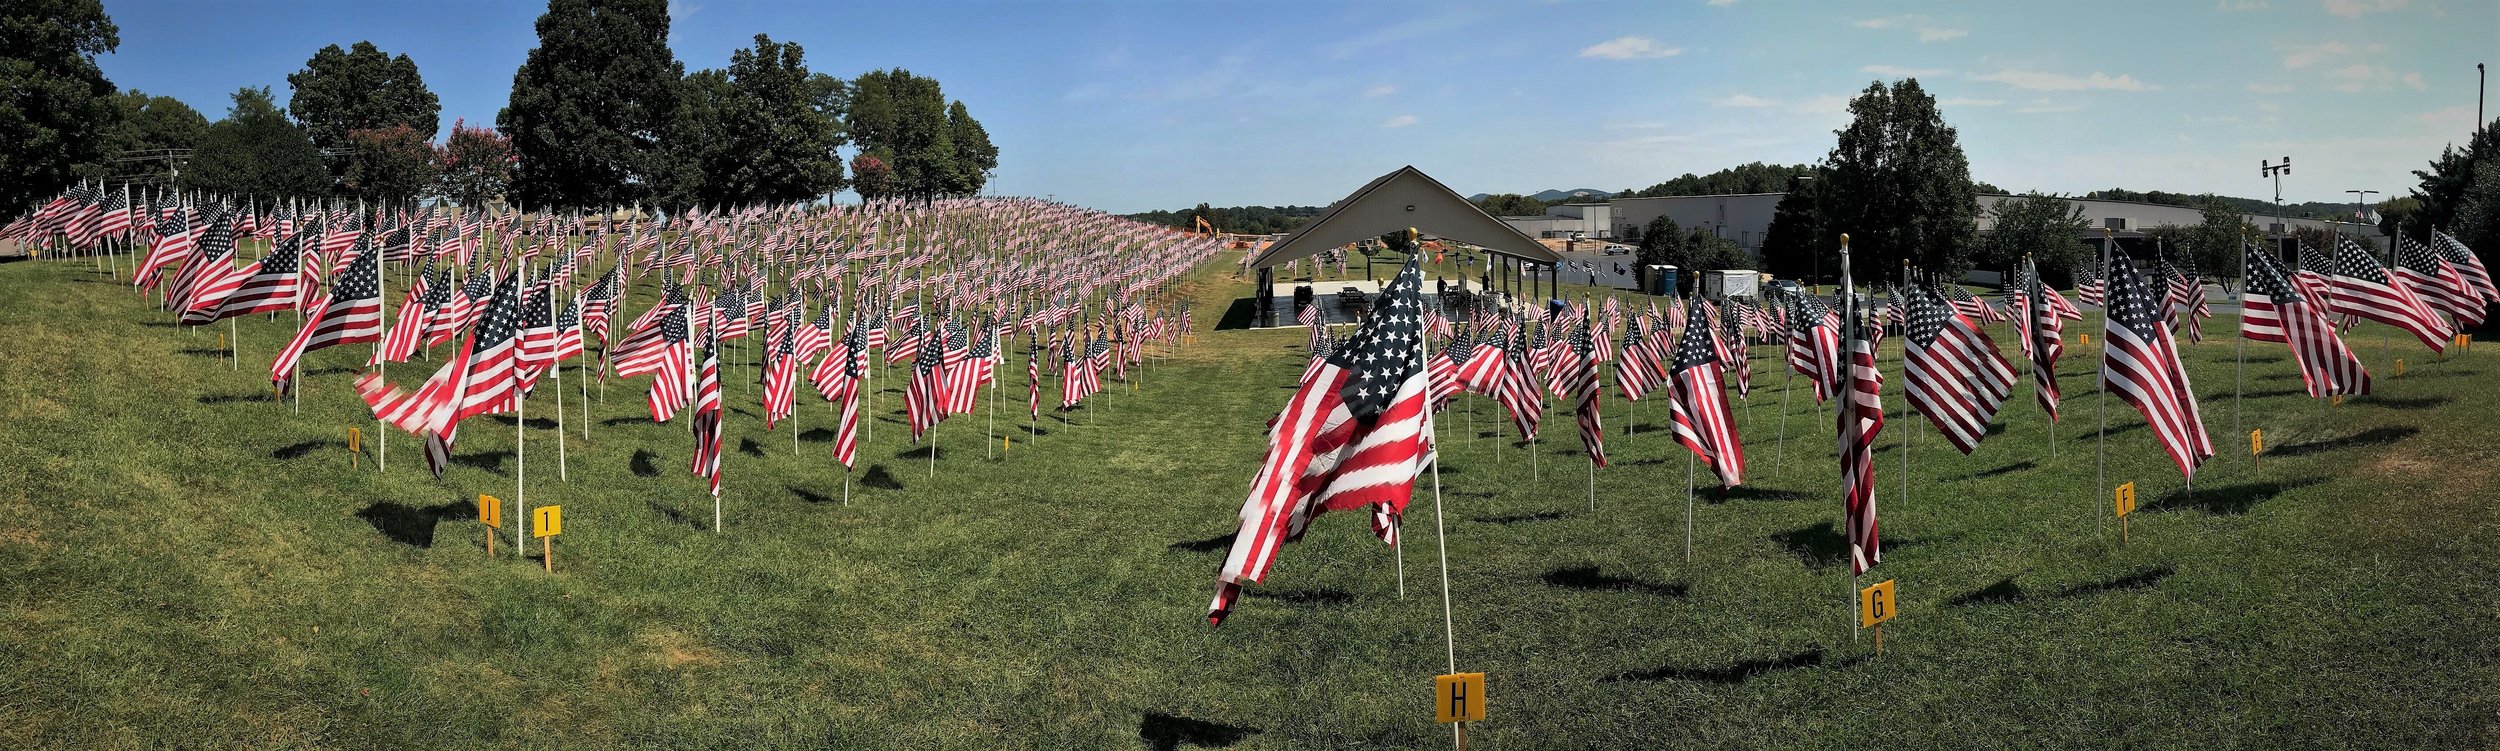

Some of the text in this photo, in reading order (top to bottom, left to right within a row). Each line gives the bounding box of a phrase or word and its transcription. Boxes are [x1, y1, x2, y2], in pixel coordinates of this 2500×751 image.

[2255, 434, 2259, 451] E
[487, 500, 491, 521] J
[2122, 488, 2127, 511] F
[1872, 590, 1884, 618] G
[1451, 682, 1466, 717] H
